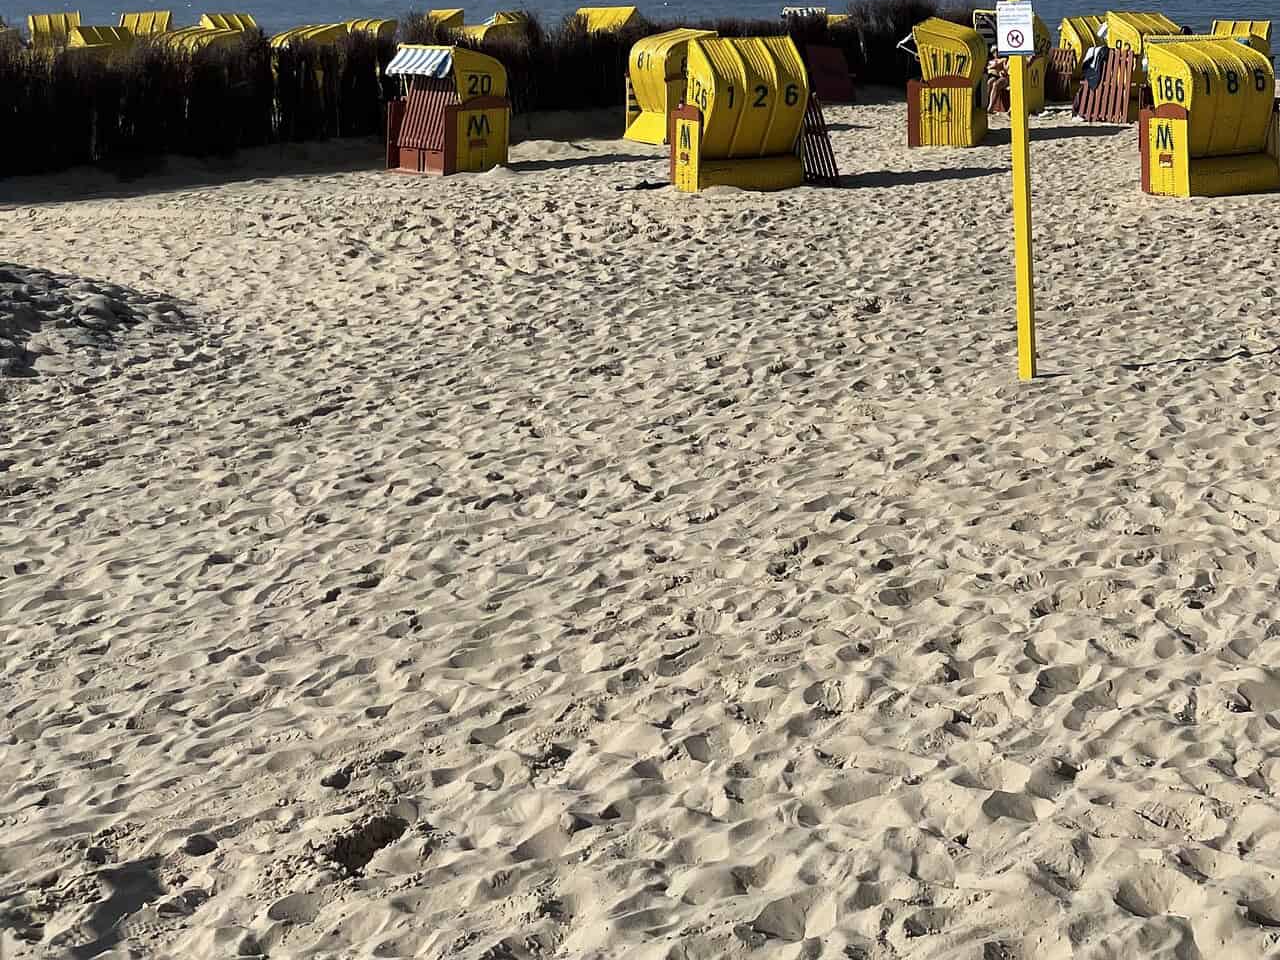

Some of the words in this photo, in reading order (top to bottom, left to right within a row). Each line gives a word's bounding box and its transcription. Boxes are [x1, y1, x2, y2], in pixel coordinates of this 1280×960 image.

[931, 52, 966, 74] 117
[468, 74, 492, 96] 20
[690, 77, 707, 111] 126
[727, 82, 799, 108] 126
[1157, 74, 1185, 102] 186
[1202, 69, 1265, 95] 186
[928, 92, 952, 113] M
[467, 114, 491, 137] M
[680, 124, 691, 150] M
[1156, 124, 1174, 150] M
